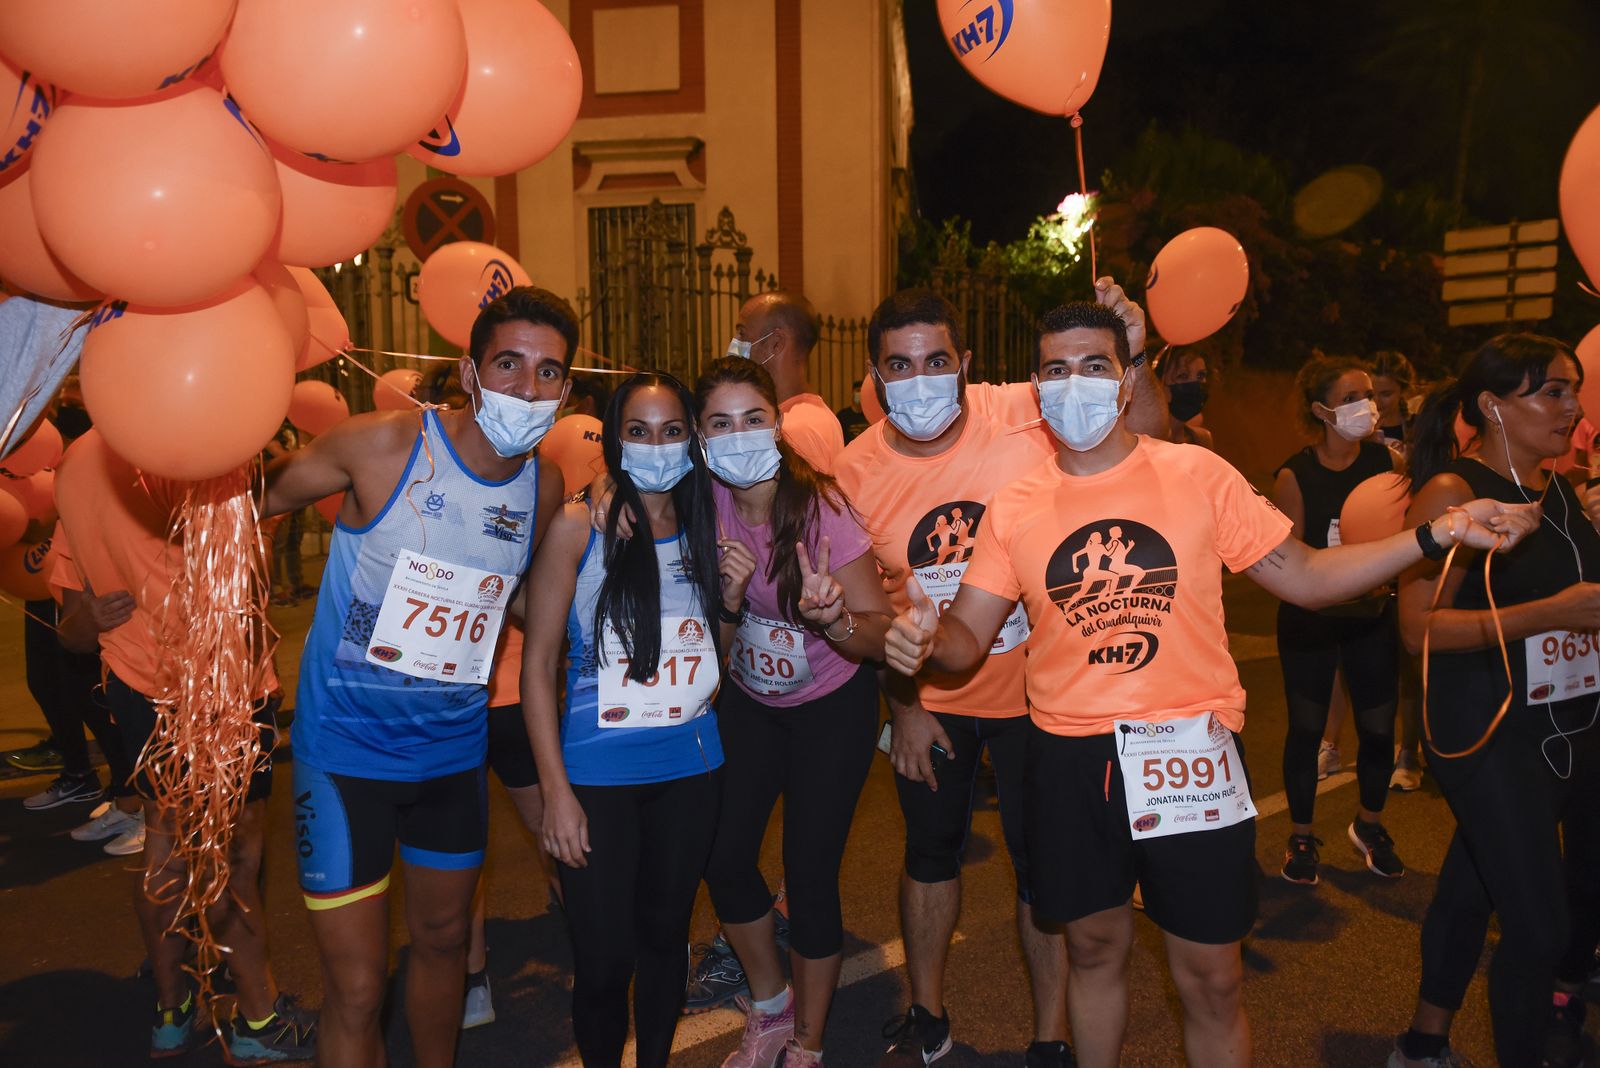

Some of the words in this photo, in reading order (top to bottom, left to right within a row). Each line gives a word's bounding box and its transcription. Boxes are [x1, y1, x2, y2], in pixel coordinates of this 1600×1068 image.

[402, 597, 488, 643] 7516
[1001, 616, 1022, 631] TÍNEZ
[1065, 608, 1085, 627] LA
[1086, 597, 1171, 618] NOCTURNA
[1081, 623, 1096, 638] del
[1096, 612, 1163, 631] Guadalquivir
[736, 637, 795, 679] 2130
[1142, 750, 1231, 791] 5991
[1146, 795, 1185, 807] JONATAN
[1187, 791, 1221, 803] FALCÓN
[1222, 785, 1237, 799] RUÍZ
[295, 790, 317, 858] Viso
